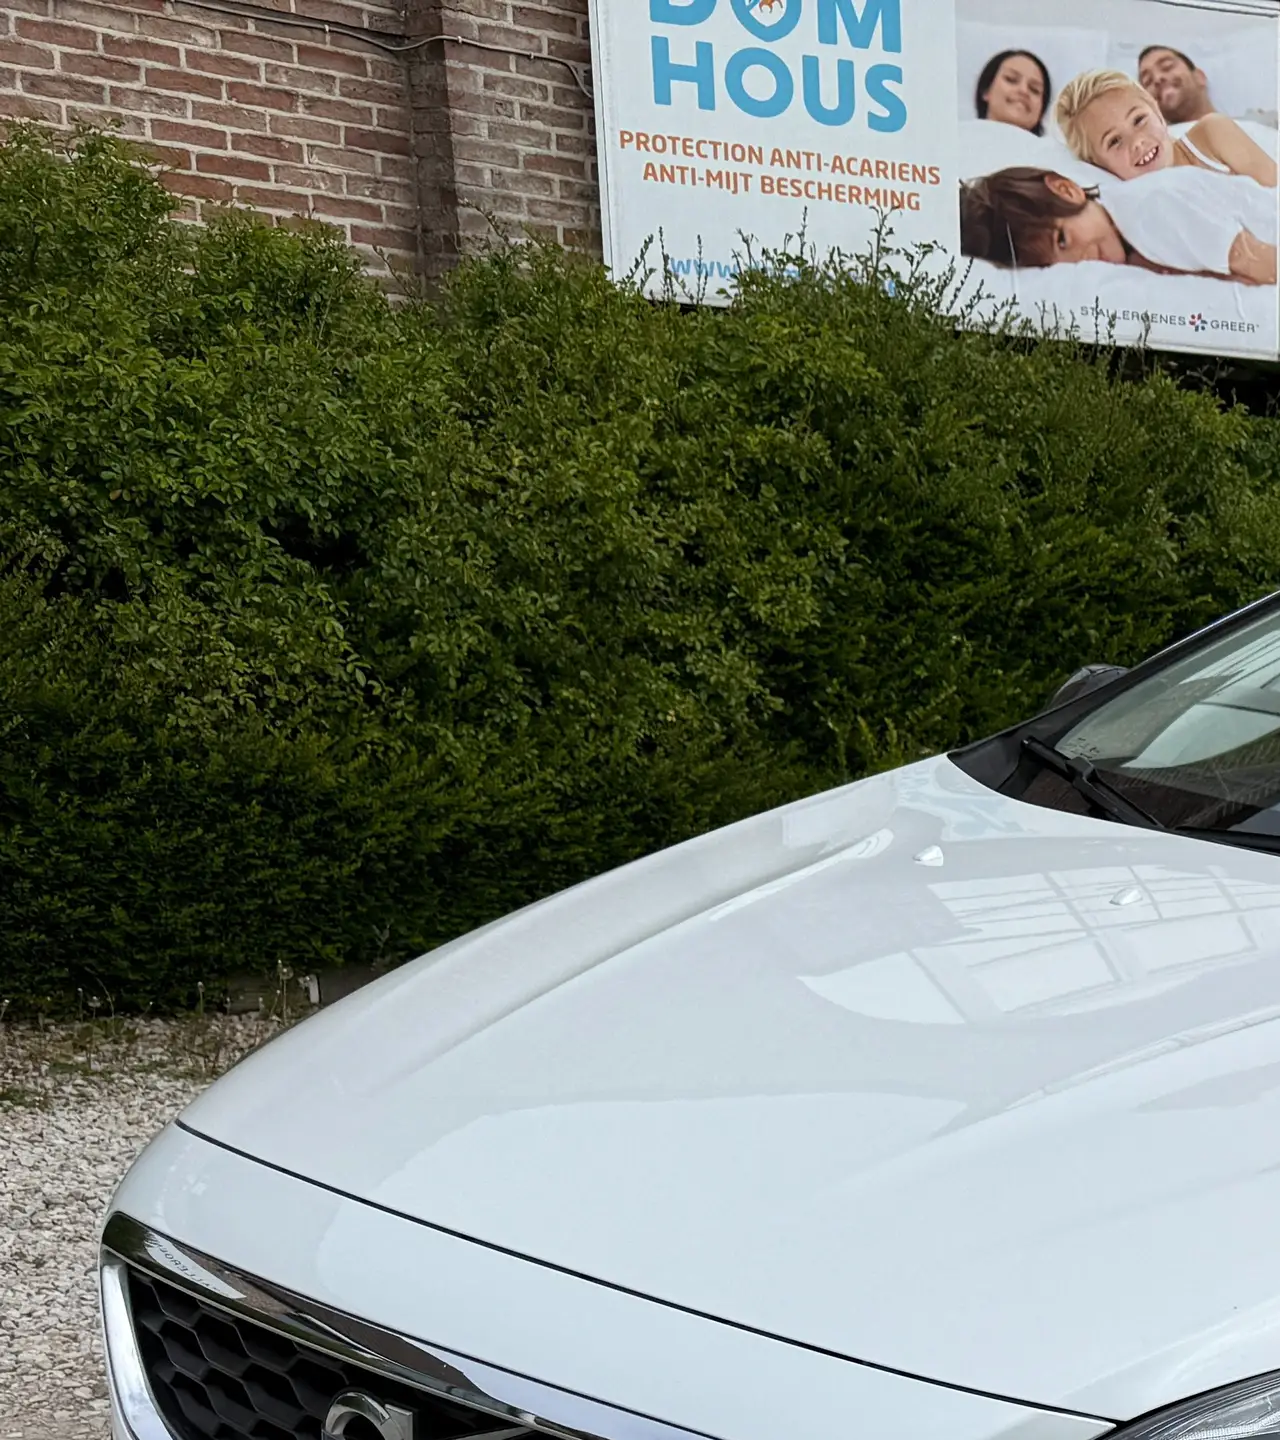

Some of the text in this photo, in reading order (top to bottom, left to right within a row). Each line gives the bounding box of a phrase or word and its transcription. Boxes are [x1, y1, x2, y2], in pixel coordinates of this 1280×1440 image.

[651, 35, 908, 133] HOUS
[619, 130, 941, 185] PROTECTION ANTI-ACARIENS
[643, 162, 921, 211] ANTI-MIJT BESCHERMING
[1211, 319, 1256, 333] GREER
